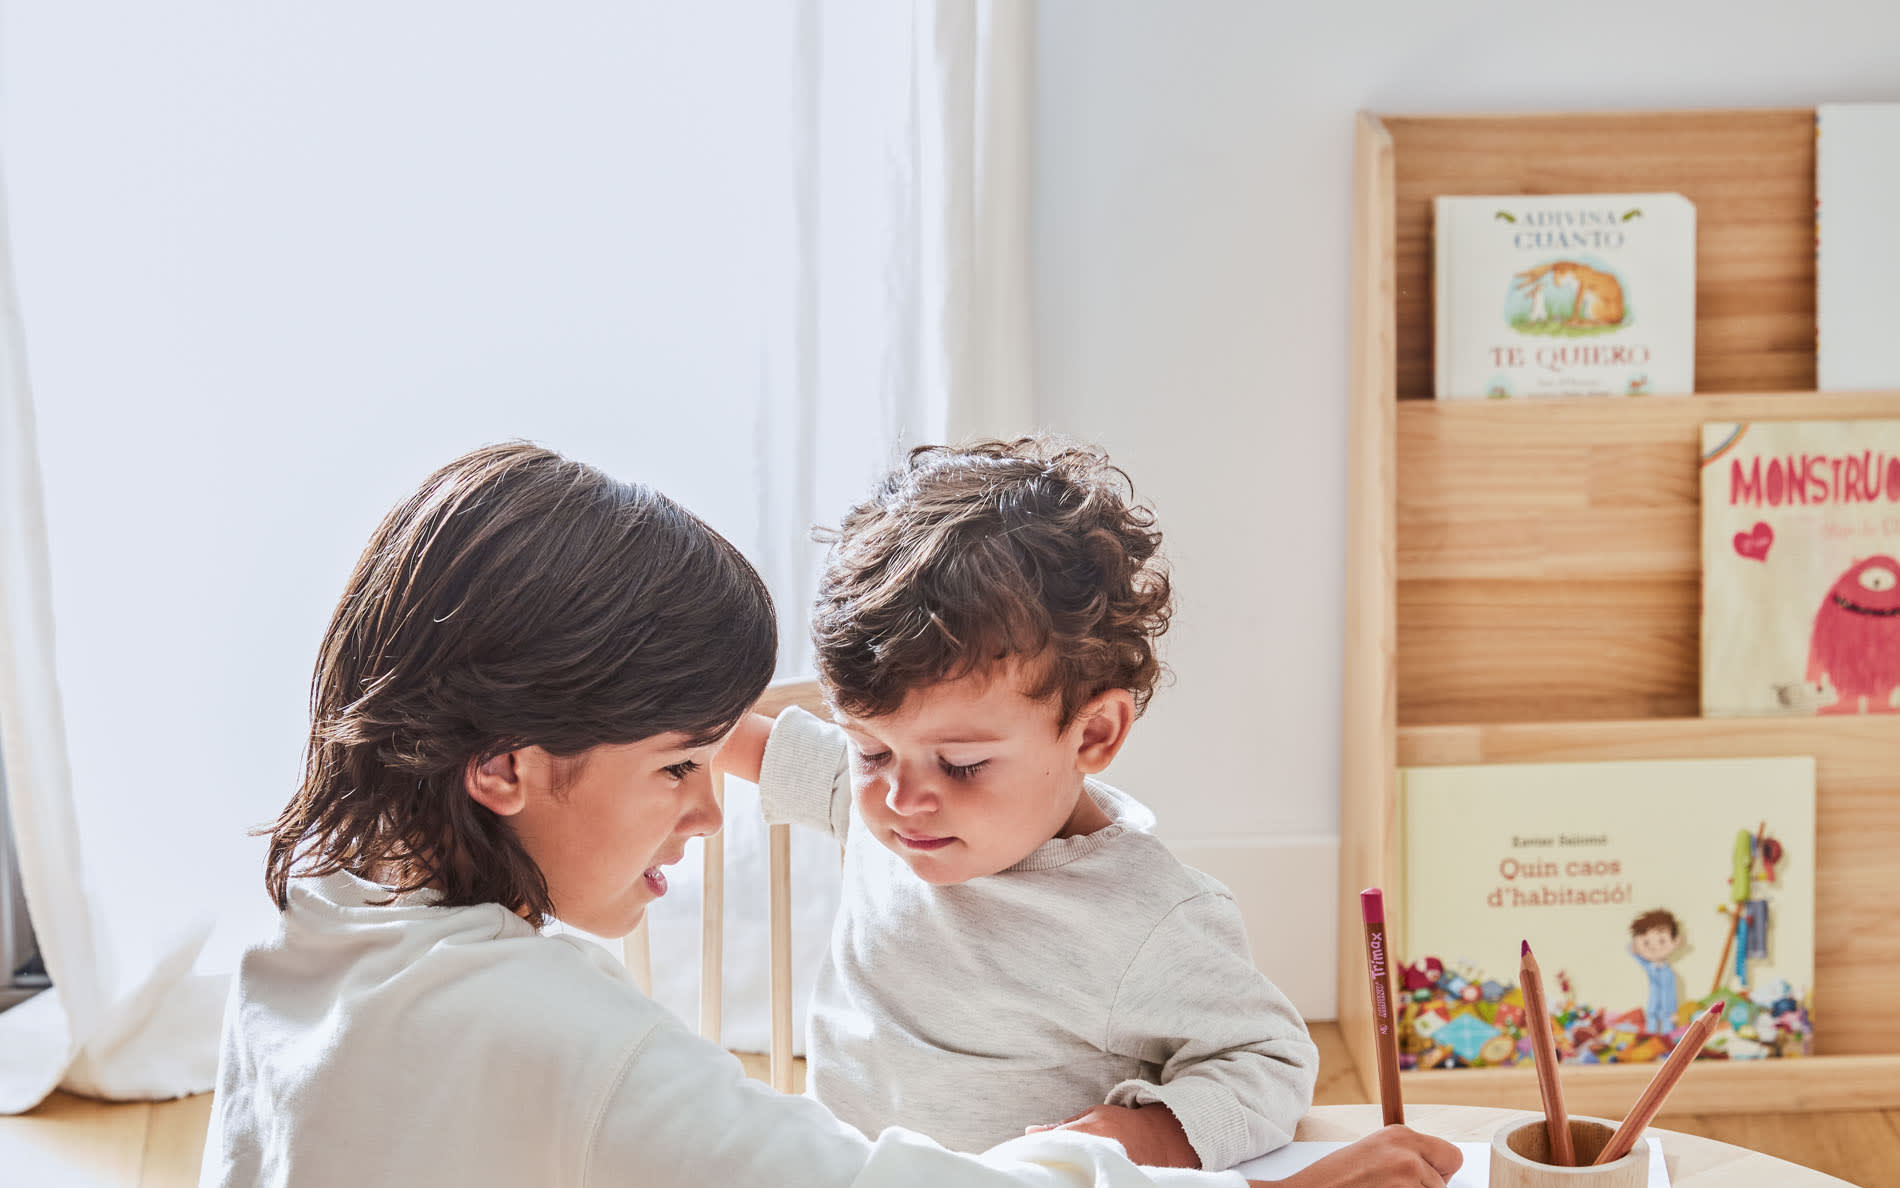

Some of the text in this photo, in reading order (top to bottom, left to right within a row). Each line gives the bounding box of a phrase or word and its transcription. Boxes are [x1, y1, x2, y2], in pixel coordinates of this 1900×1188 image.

[1490, 345, 1651, 371] TE QUIERO
[1729, 449, 1900, 508] MONSTRUO
[1499, 857, 1622, 880] Quin caos
[1486, 883, 1634, 908] d'habitació!
[1370, 931, 1387, 980] Trimax
